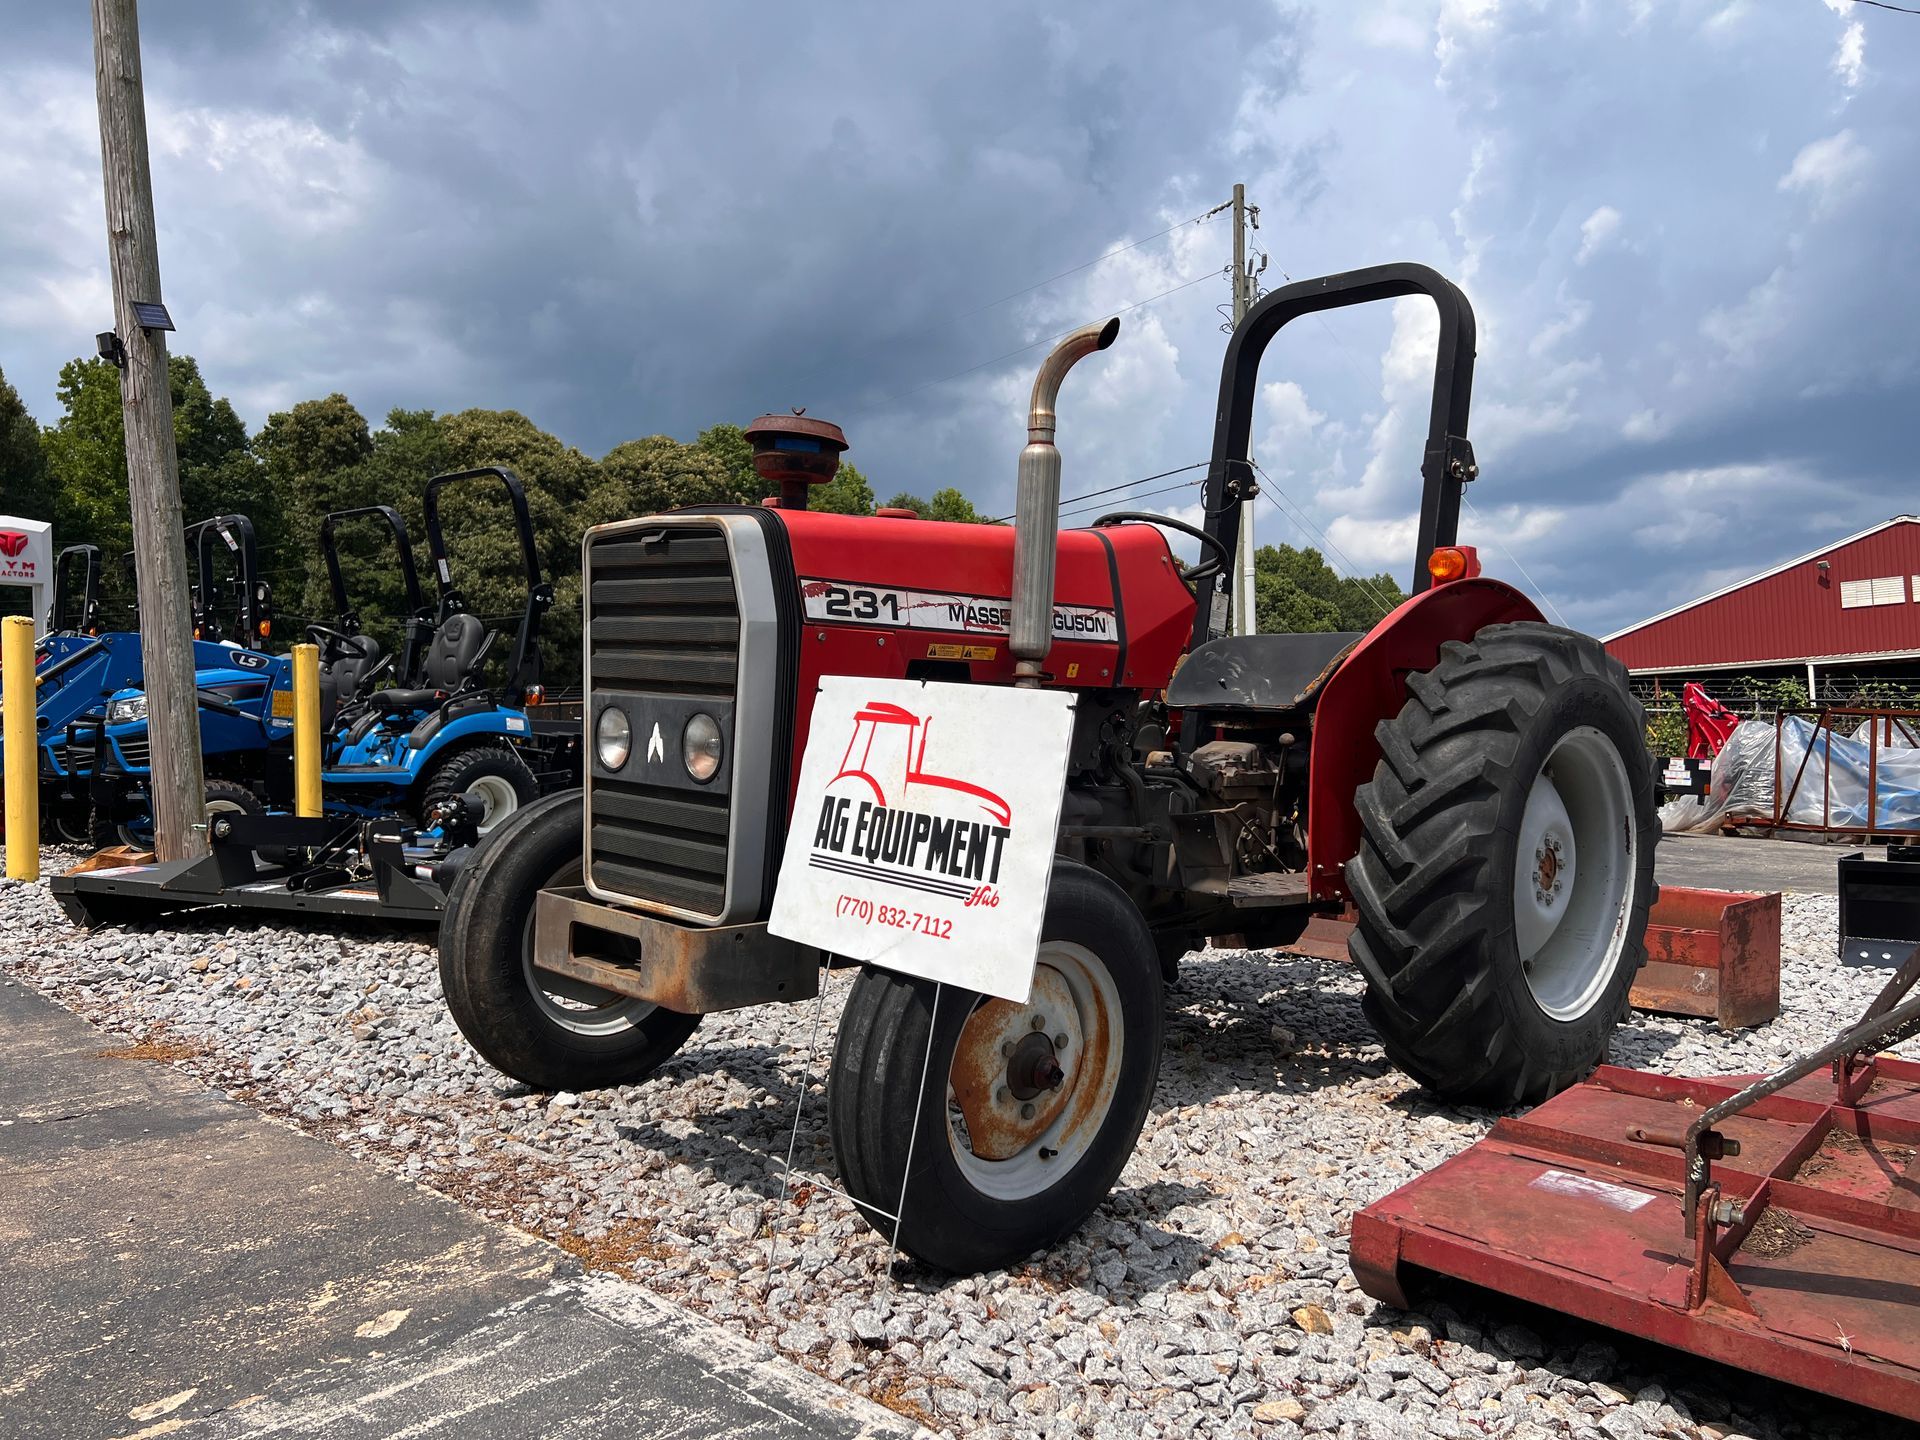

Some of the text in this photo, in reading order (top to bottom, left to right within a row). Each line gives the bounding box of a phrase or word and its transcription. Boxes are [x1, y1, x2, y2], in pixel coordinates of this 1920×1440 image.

[1, 570, 35, 578] ACTORS
[3, 560, 35, 570] YM
[825, 588, 899, 621] 231
[949, 605, 1106, 633] MASSE GUSON
[239, 655, 257, 667] LS
[813, 795, 1012, 885] AG EQUIPMENT
[964, 885, 1000, 908] Hub
[835, 894, 954, 940] (770) 832-7112
